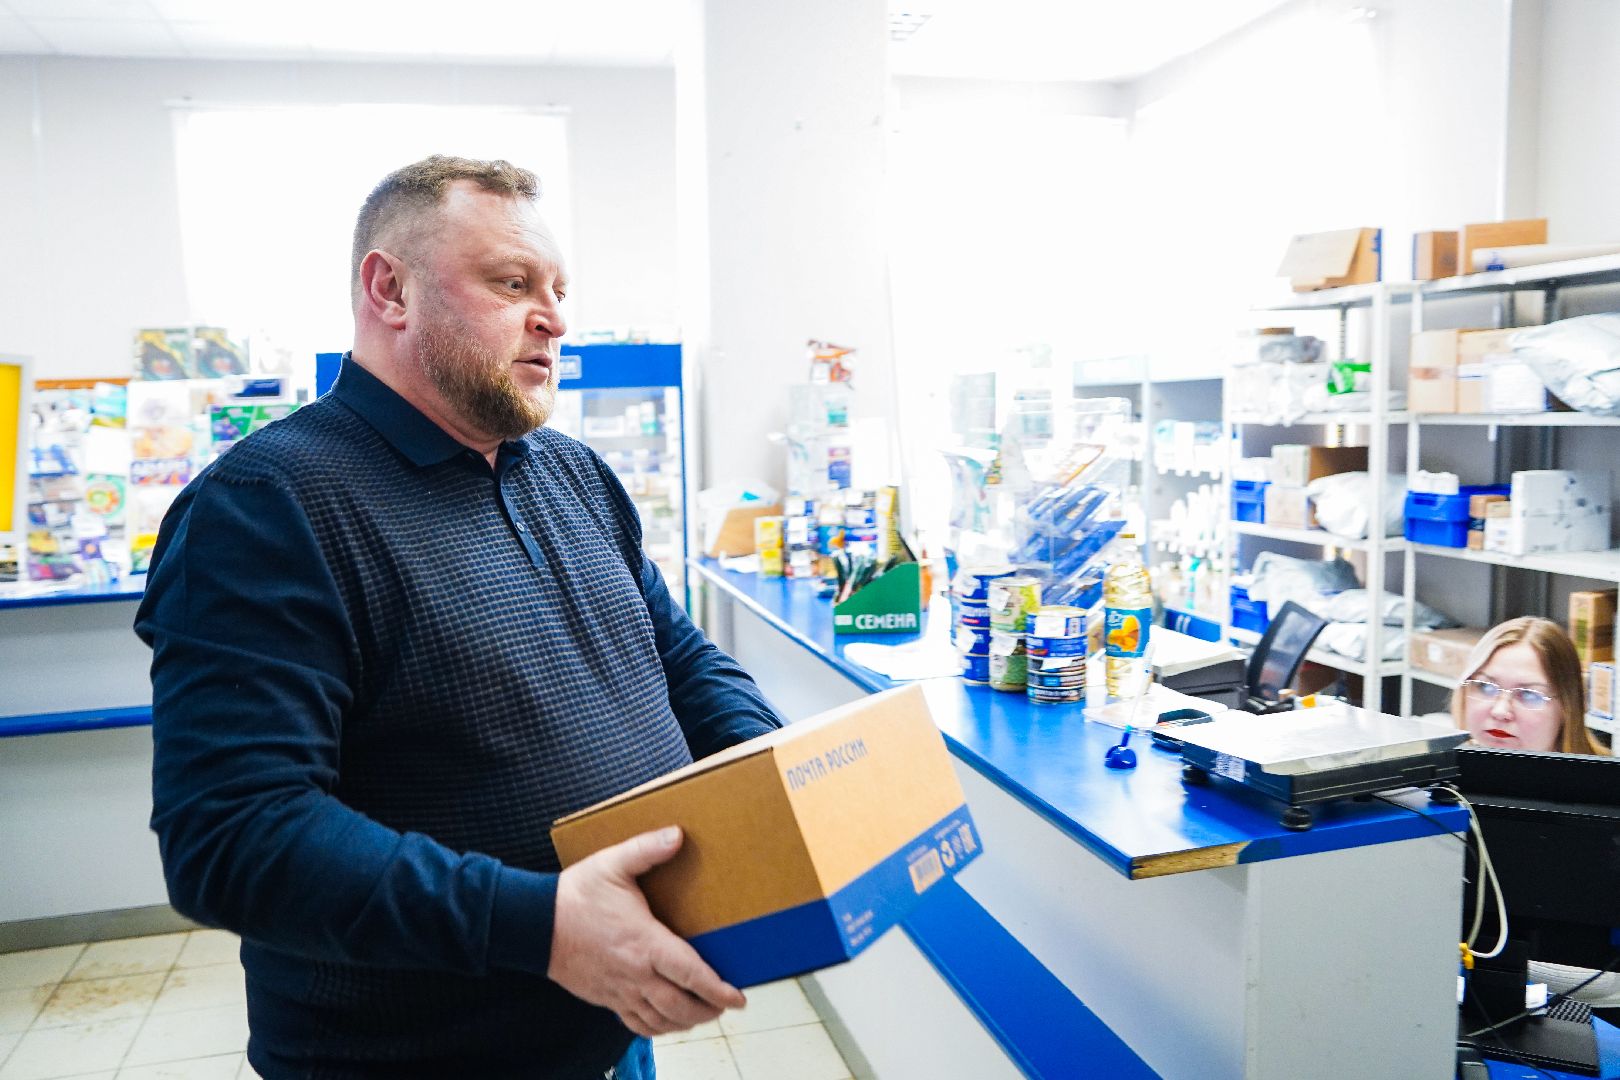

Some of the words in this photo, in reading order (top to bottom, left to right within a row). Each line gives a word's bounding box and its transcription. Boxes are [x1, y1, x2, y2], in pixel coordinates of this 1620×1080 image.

[855, 613, 917, 629] СЕМЕНА
[786, 756, 827, 790] ПОЧТА
[825, 738, 868, 771] РОССИИ
